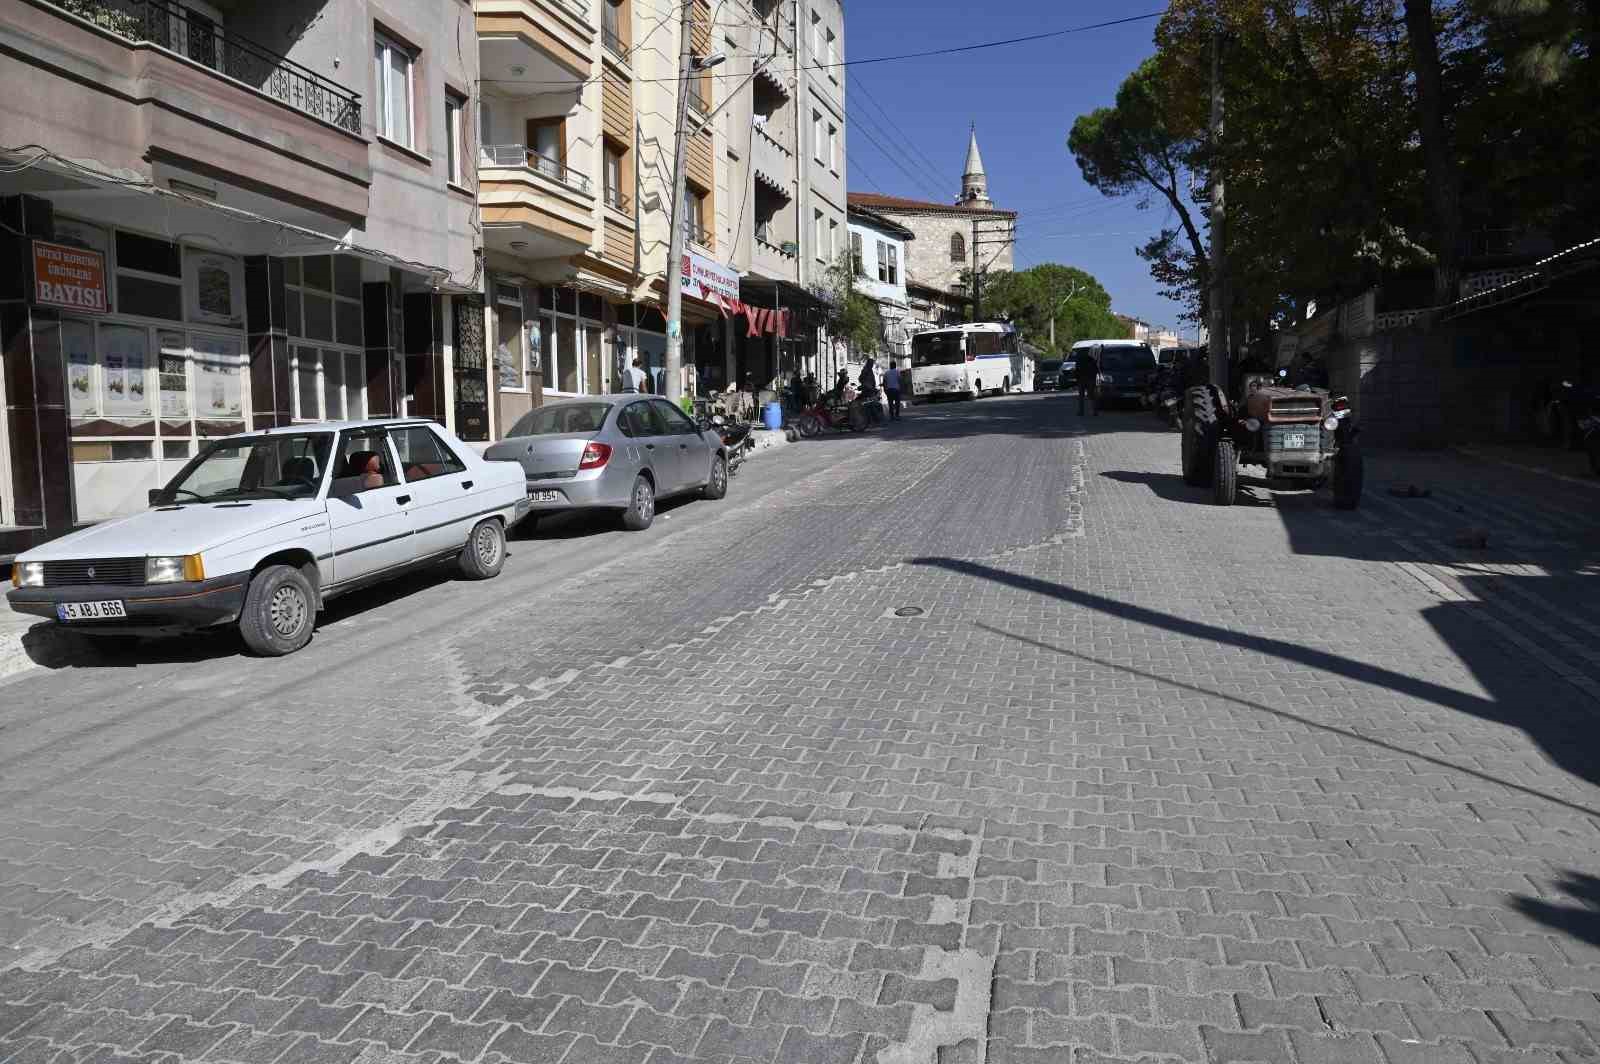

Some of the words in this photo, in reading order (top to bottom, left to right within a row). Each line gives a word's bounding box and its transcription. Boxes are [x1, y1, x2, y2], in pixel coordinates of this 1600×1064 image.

[39, 281, 103, 307] BAYİSİ
[80, 603, 98, 617] ABJ
[101, 602, 122, 616] 666
